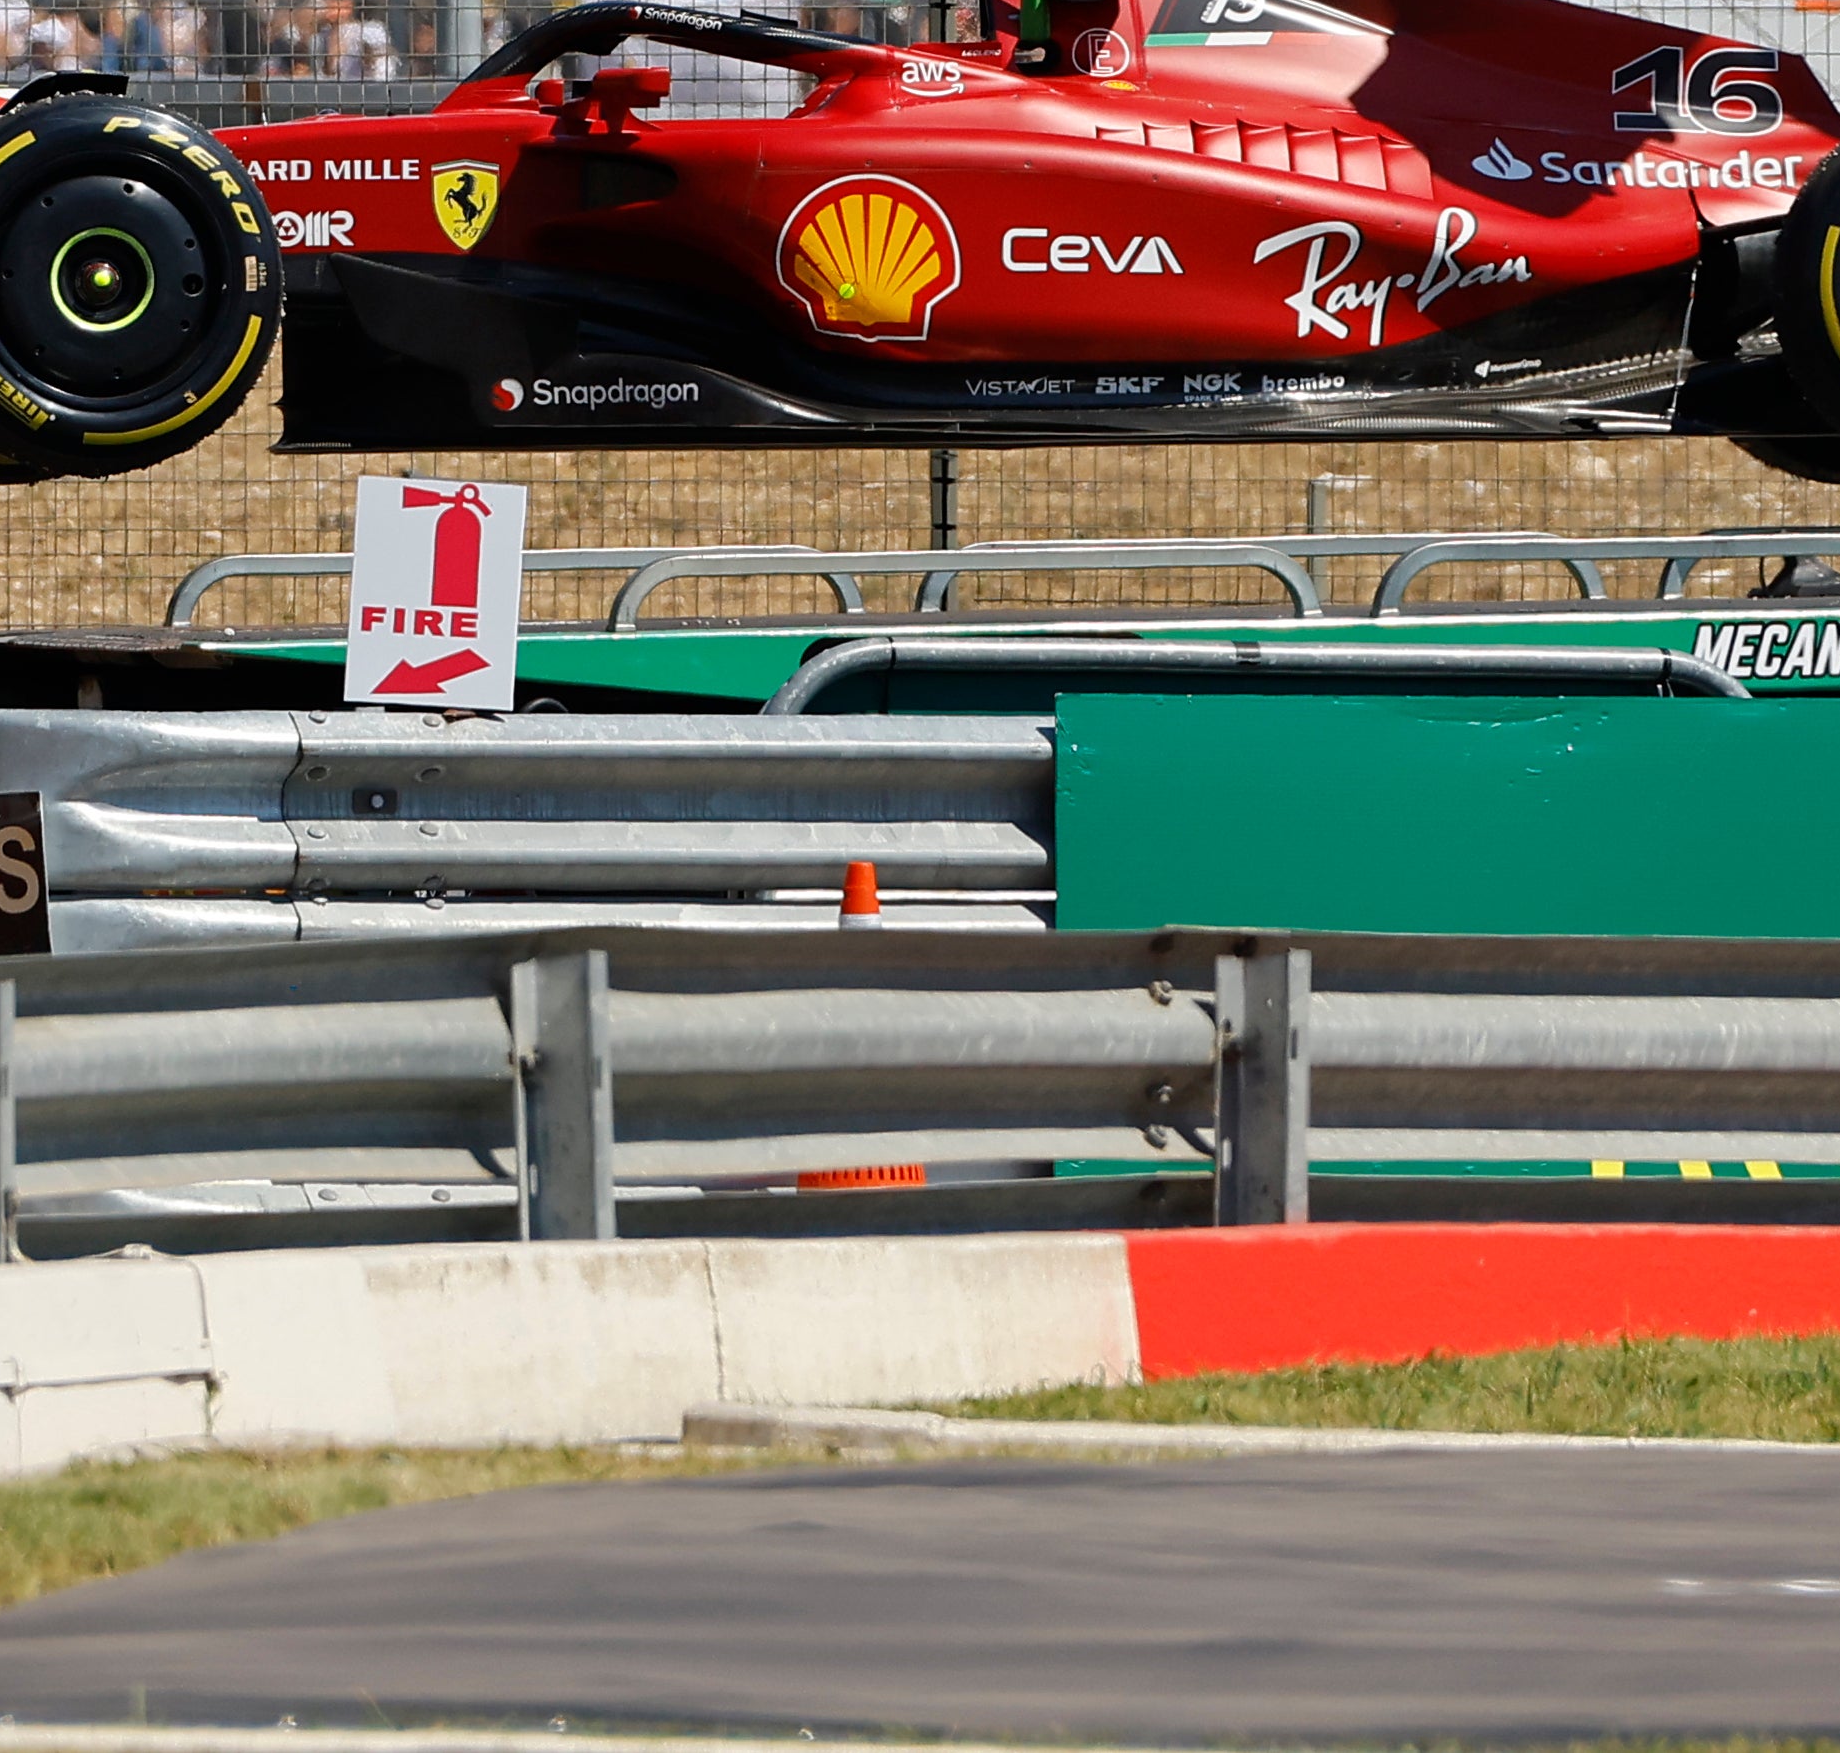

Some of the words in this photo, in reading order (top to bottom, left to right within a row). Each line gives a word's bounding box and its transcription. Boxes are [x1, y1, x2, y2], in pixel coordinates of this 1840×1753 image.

[644, 6, 723, 31] Snapdragon
[901, 60, 960, 83] aws
[1612, 45, 1783, 137] 16
[148, 125, 261, 234] ZERO
[324, 159, 420, 180] MILLE
[1543, 149, 1803, 189] Santander
[532, 377, 699, 409] Snapdragon
[1095, 376, 1164, 394] SKF
[1183, 372, 1242, 393] NGK
[1261, 372, 1345, 394] brembo
[362, 604, 479, 638] FIRE
